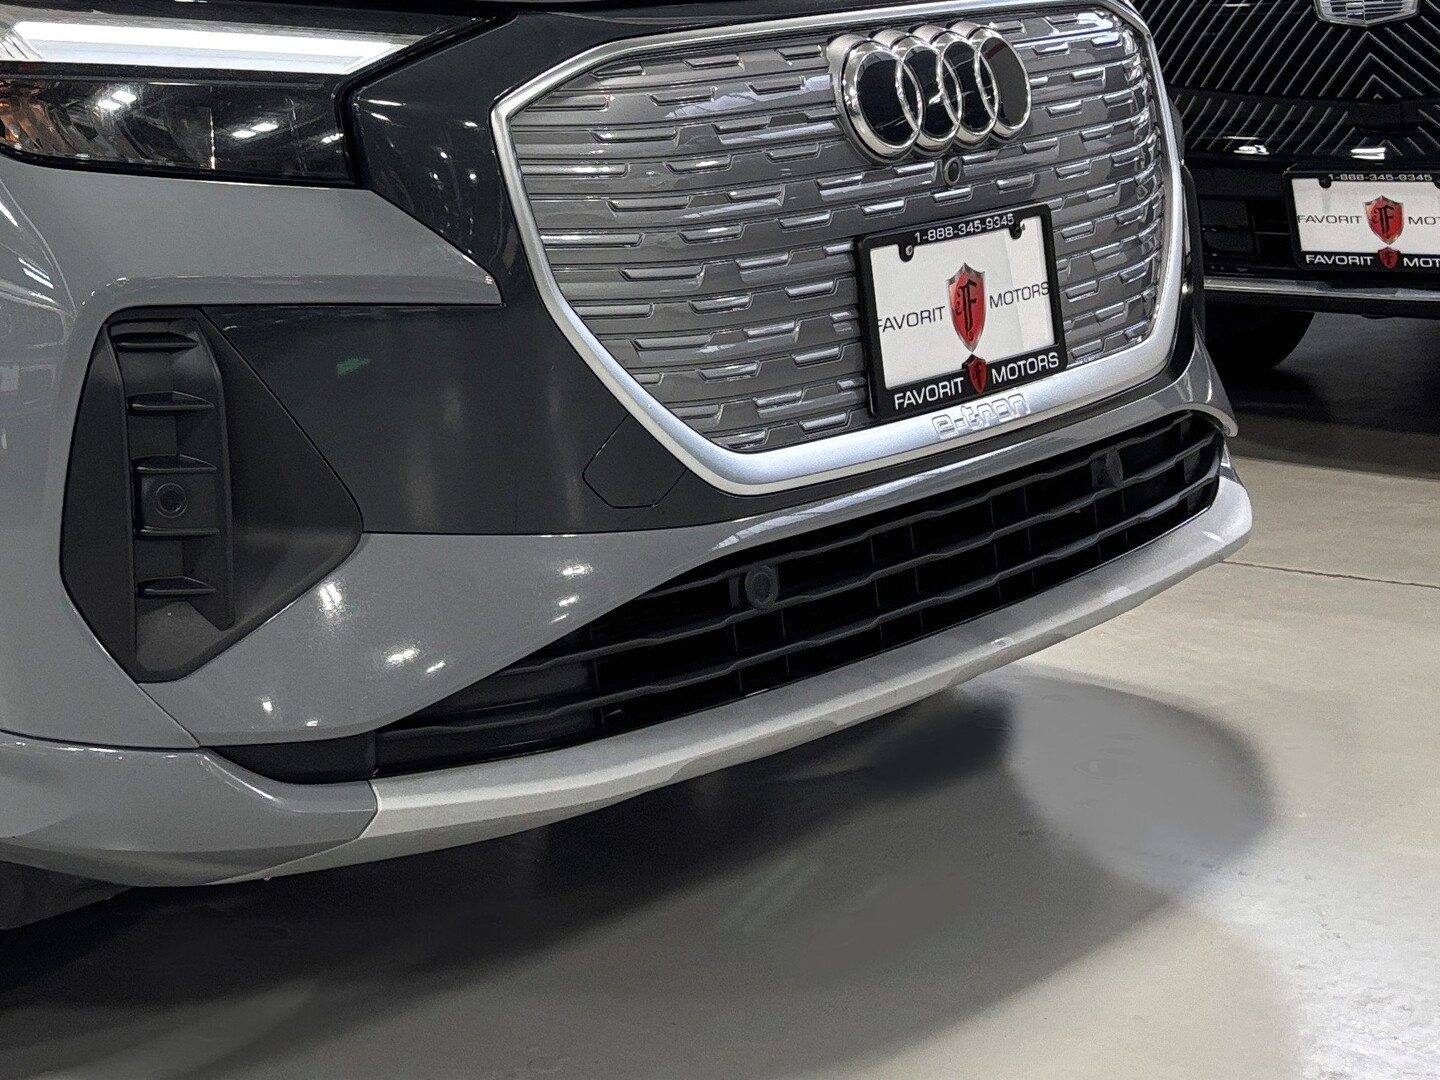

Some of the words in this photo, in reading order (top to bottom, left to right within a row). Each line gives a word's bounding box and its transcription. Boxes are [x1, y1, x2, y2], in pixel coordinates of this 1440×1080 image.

[914, 213, 1015, 243] 1-888-345-9345
[1297, 214, 1362, 224] FAVORIT
[1305, 254, 1374, 265] FAVORIT
[989, 281, 1049, 309] MOTORS
[894, 377, 964, 410] FAVORIT
[991, 352, 1059, 384] MOTORS
[932, 393, 1032, 439] e-tron
